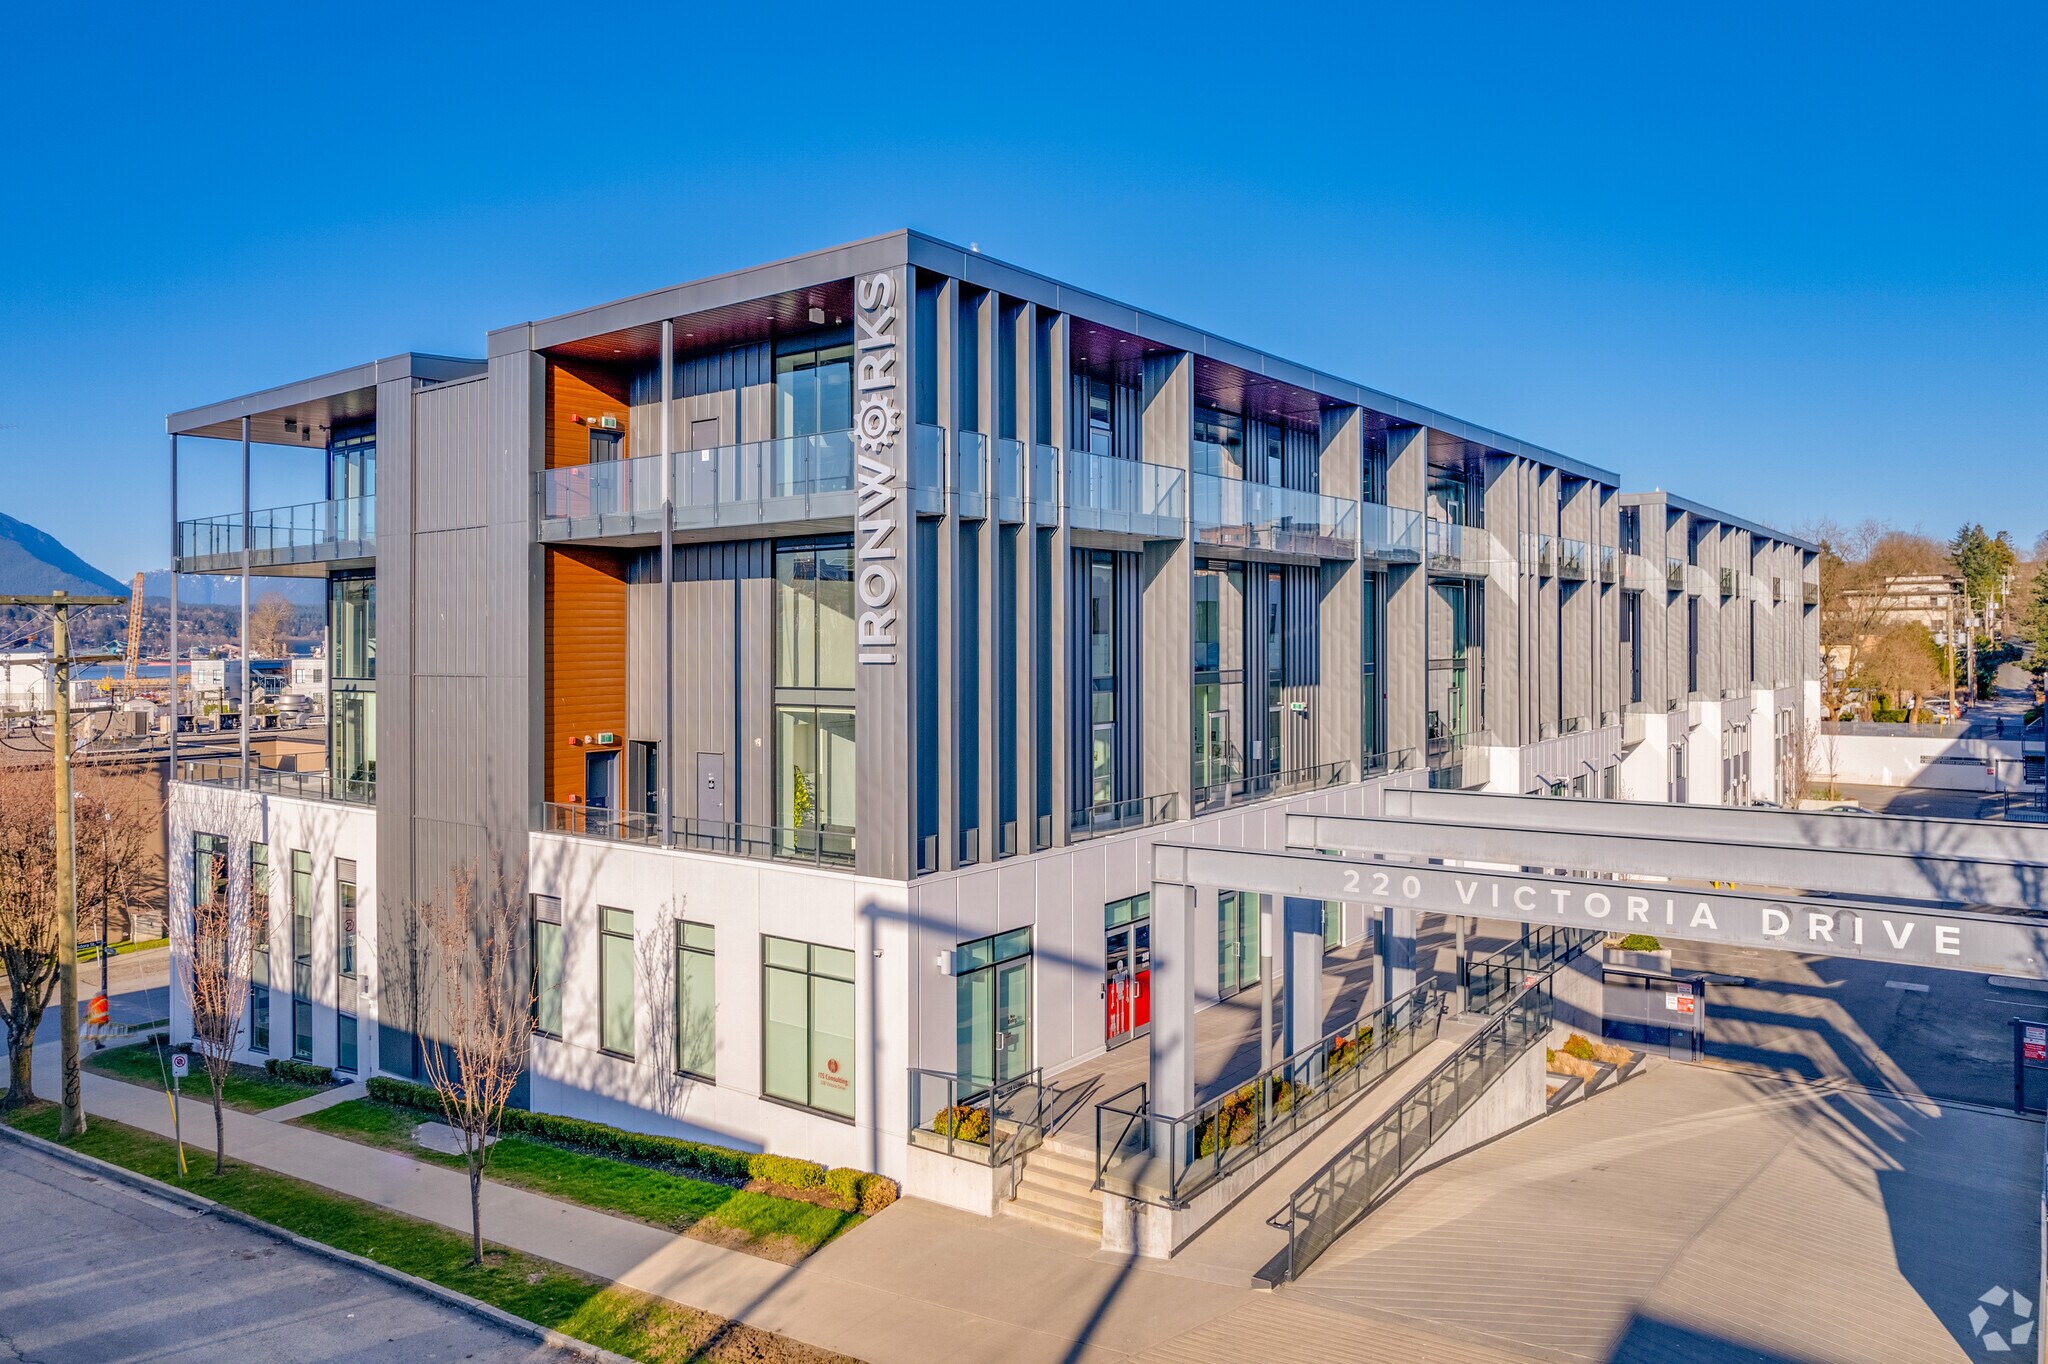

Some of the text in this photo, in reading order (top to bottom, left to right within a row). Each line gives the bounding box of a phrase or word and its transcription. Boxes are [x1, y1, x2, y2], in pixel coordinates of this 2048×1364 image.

[855, 272, 901, 664] IRONWORKS
[1343, 870, 1961, 956] 220 VICTORIA DRIVE
[825, 1074, 849, 1087] Consulting
